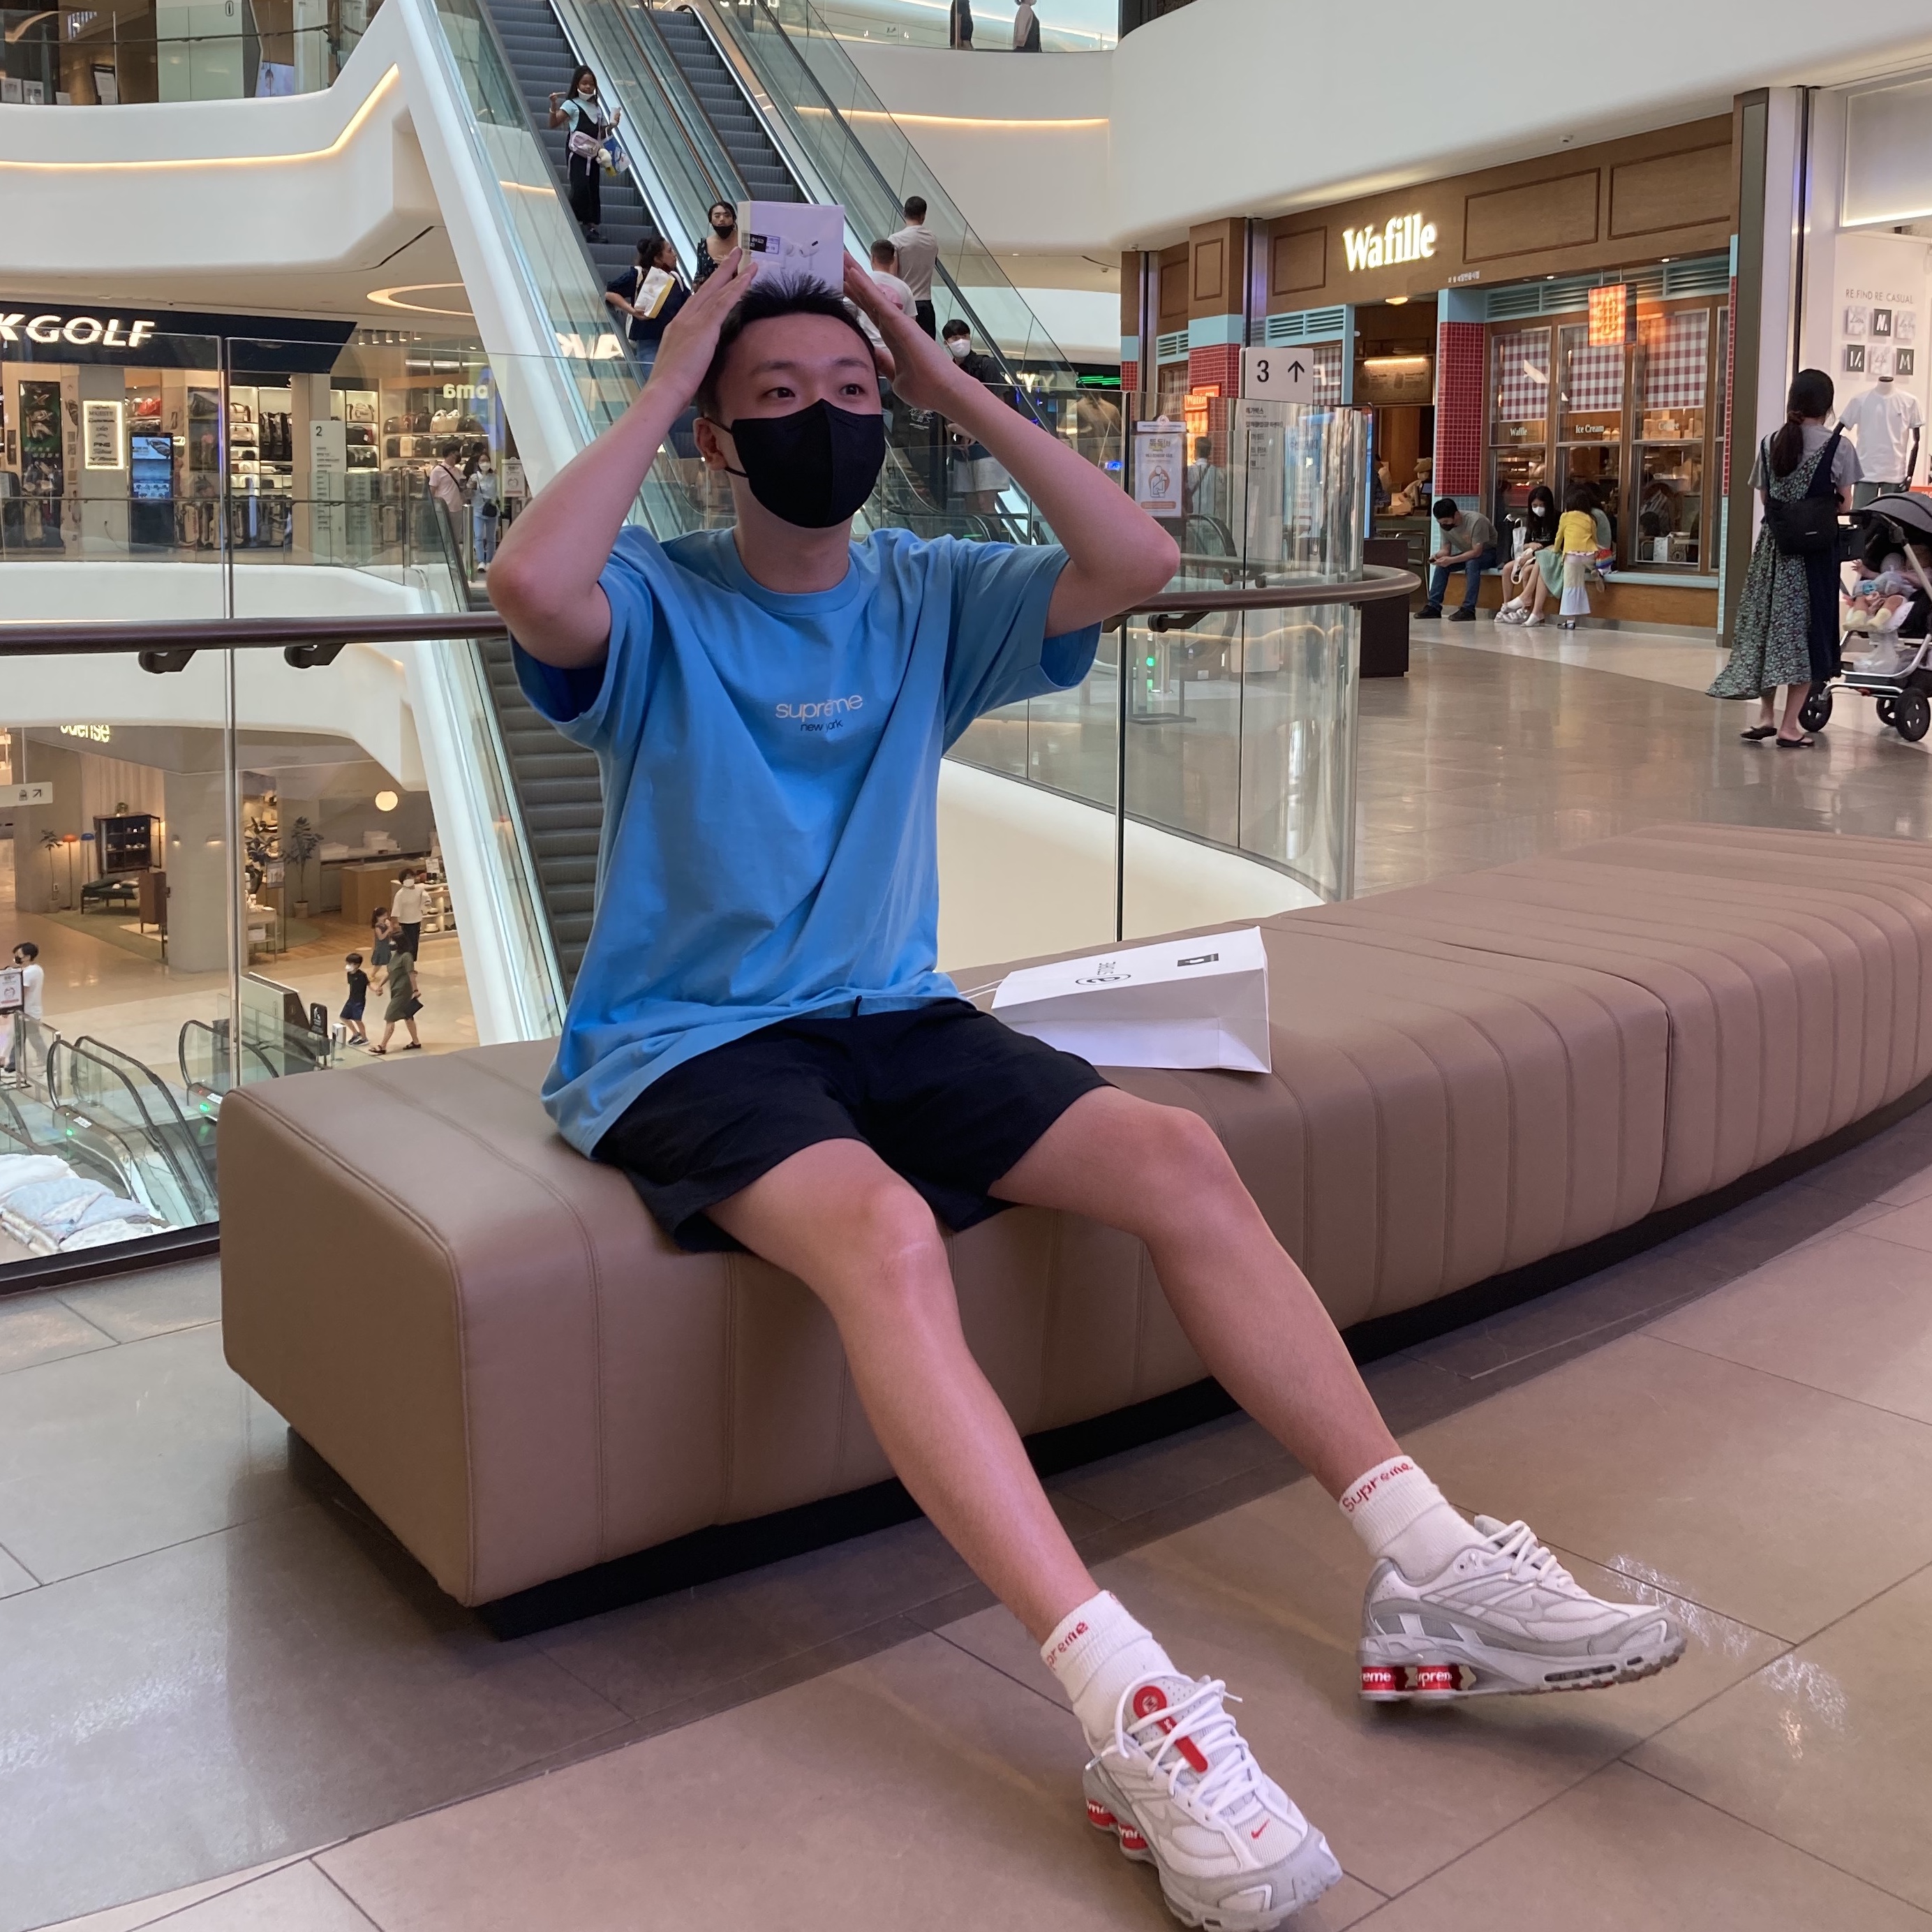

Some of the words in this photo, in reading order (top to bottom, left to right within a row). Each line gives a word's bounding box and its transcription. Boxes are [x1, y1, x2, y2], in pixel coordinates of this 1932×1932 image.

[1342, 212, 1436, 272] Wafille
[1886, 293, 1913, 304] CASUAL
[1256, 359, 1270, 382] 3
[315, 426, 322, 437] 2
[1575, 424, 1584, 433] Ice
[1585, 424, 1605, 433] Cream
[800, 722, 824, 732] new
